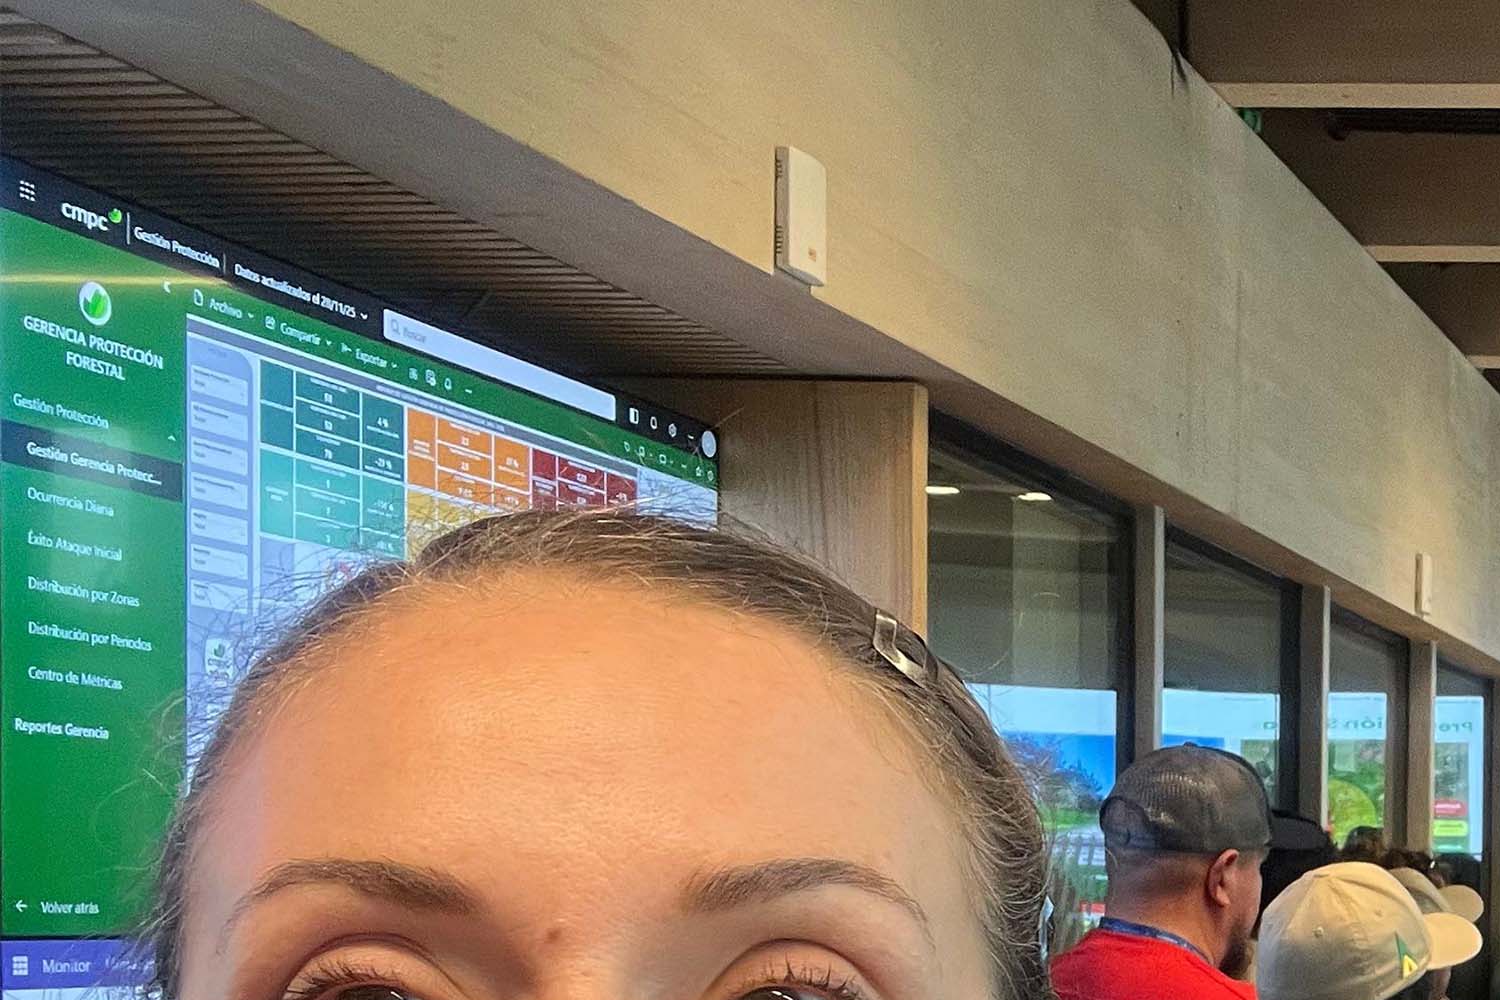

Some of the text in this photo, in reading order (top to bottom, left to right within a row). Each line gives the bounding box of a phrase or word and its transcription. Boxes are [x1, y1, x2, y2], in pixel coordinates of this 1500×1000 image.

[61, 203, 109, 231] cmpc
[134, 227, 220, 268] Gestión Protección
[235, 264, 260, 283] Datos
[209, 298, 242, 318] Archivo
[23, 315, 164, 369] GERENCIA PROTECCIÓN
[280, 323, 321, 345] Compartir
[66, 351, 126, 380] FORESTAL
[355, 348, 387, 368] Exportar
[13, 393, 109, 429] Gestión Protección
[26, 442, 68, 462] Gestión
[70, 452, 115, 474] Gerencia
[27, 487, 83, 506] Ocurrencia
[55, 537, 92, 557] Ataque
[94, 545, 122, 561] Inicial
[28, 576, 140, 607] Distribución por Zonas
[28, 621, 90, 643] Distribución
[91, 633, 109, 646] por
[28, 666, 123, 690] Centro de Métricas
[14, 717, 109, 740] Reportes Gerencia
[41, 900, 100, 914] Volver atrás
[42, 958, 92, 973] Monitor
